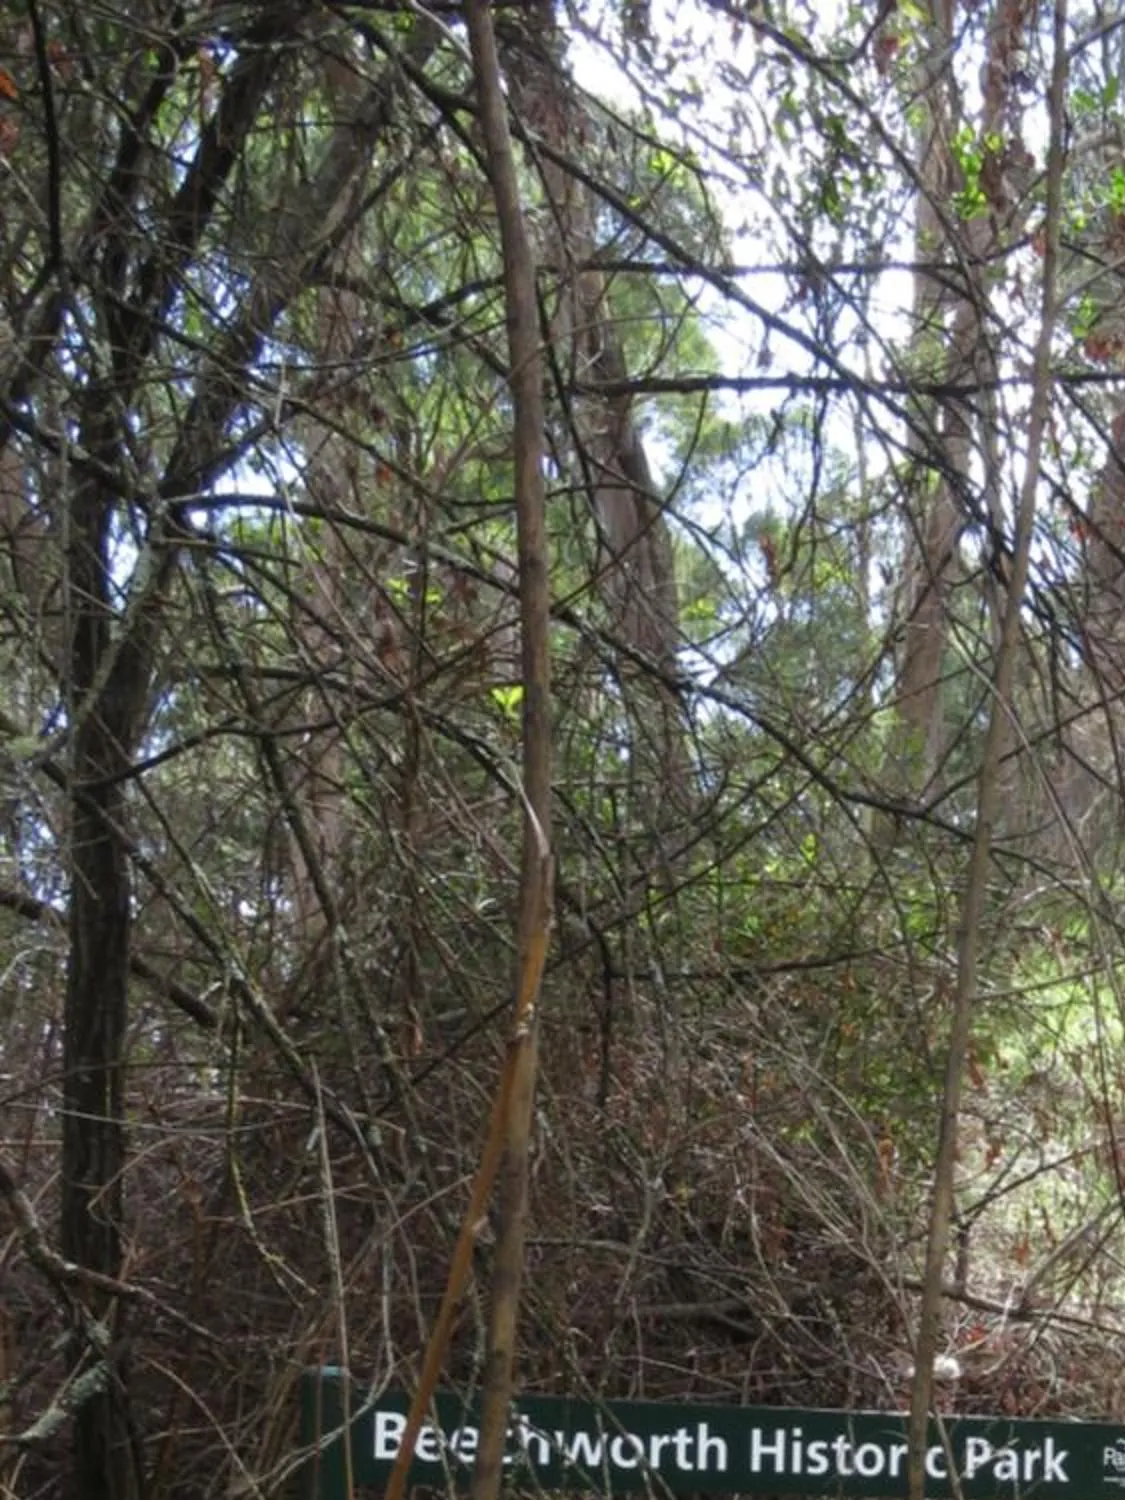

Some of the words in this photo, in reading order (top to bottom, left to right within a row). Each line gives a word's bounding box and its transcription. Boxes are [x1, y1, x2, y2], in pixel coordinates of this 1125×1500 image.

[373, 1411, 728, 1471] Beehworth
[750, 1427, 947, 1479] Historc
[965, 1436, 1069, 1482] Park
